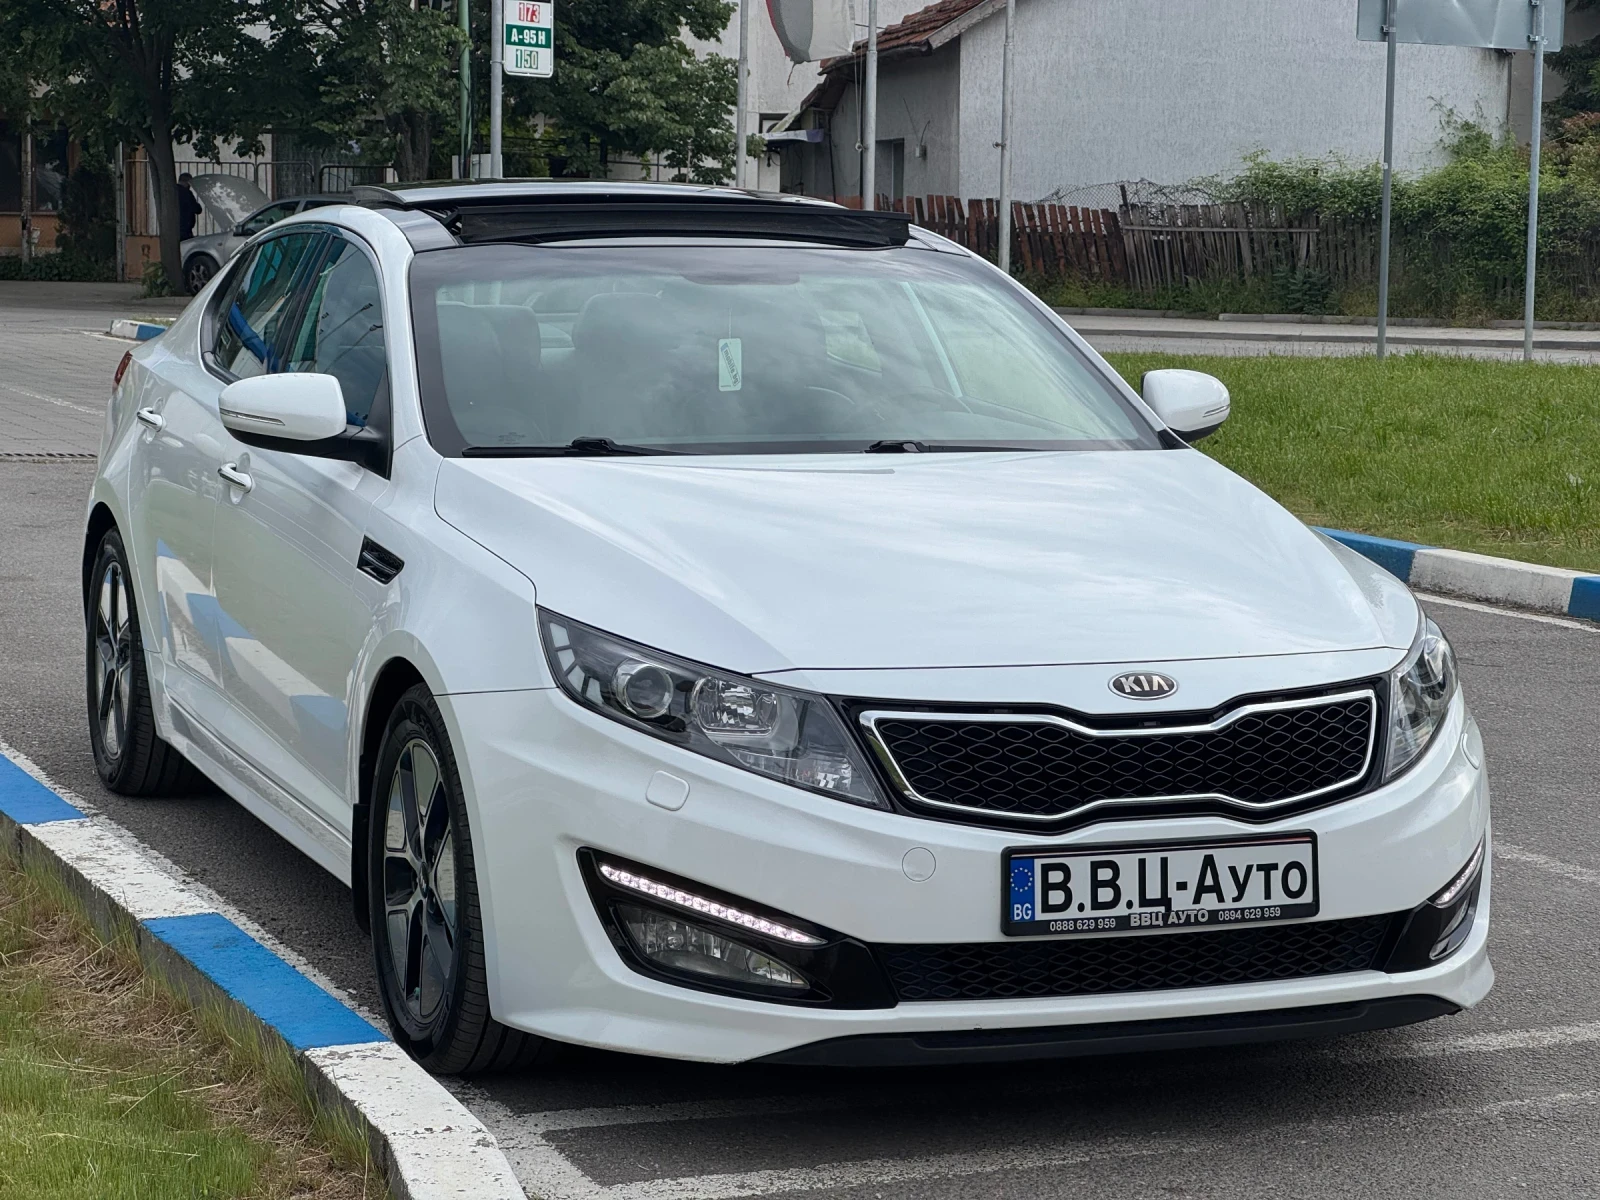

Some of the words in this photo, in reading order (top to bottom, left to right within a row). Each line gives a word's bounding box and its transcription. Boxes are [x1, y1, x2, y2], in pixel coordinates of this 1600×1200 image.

[518, 2, 540, 23] 173
[515, 49, 538, 70] 150
[1118, 675, 1170, 693] KIA
[1013, 902, 1032, 921] BG
[1218, 910, 1242, 921] 0894
[1244, 908, 1262, 919] 629
[1263, 906, 1281, 917] 959
[1049, 920, 1075, 931] 0888
[1076, 918, 1096, 930] 629
[1097, 918, 1116, 929] 959
